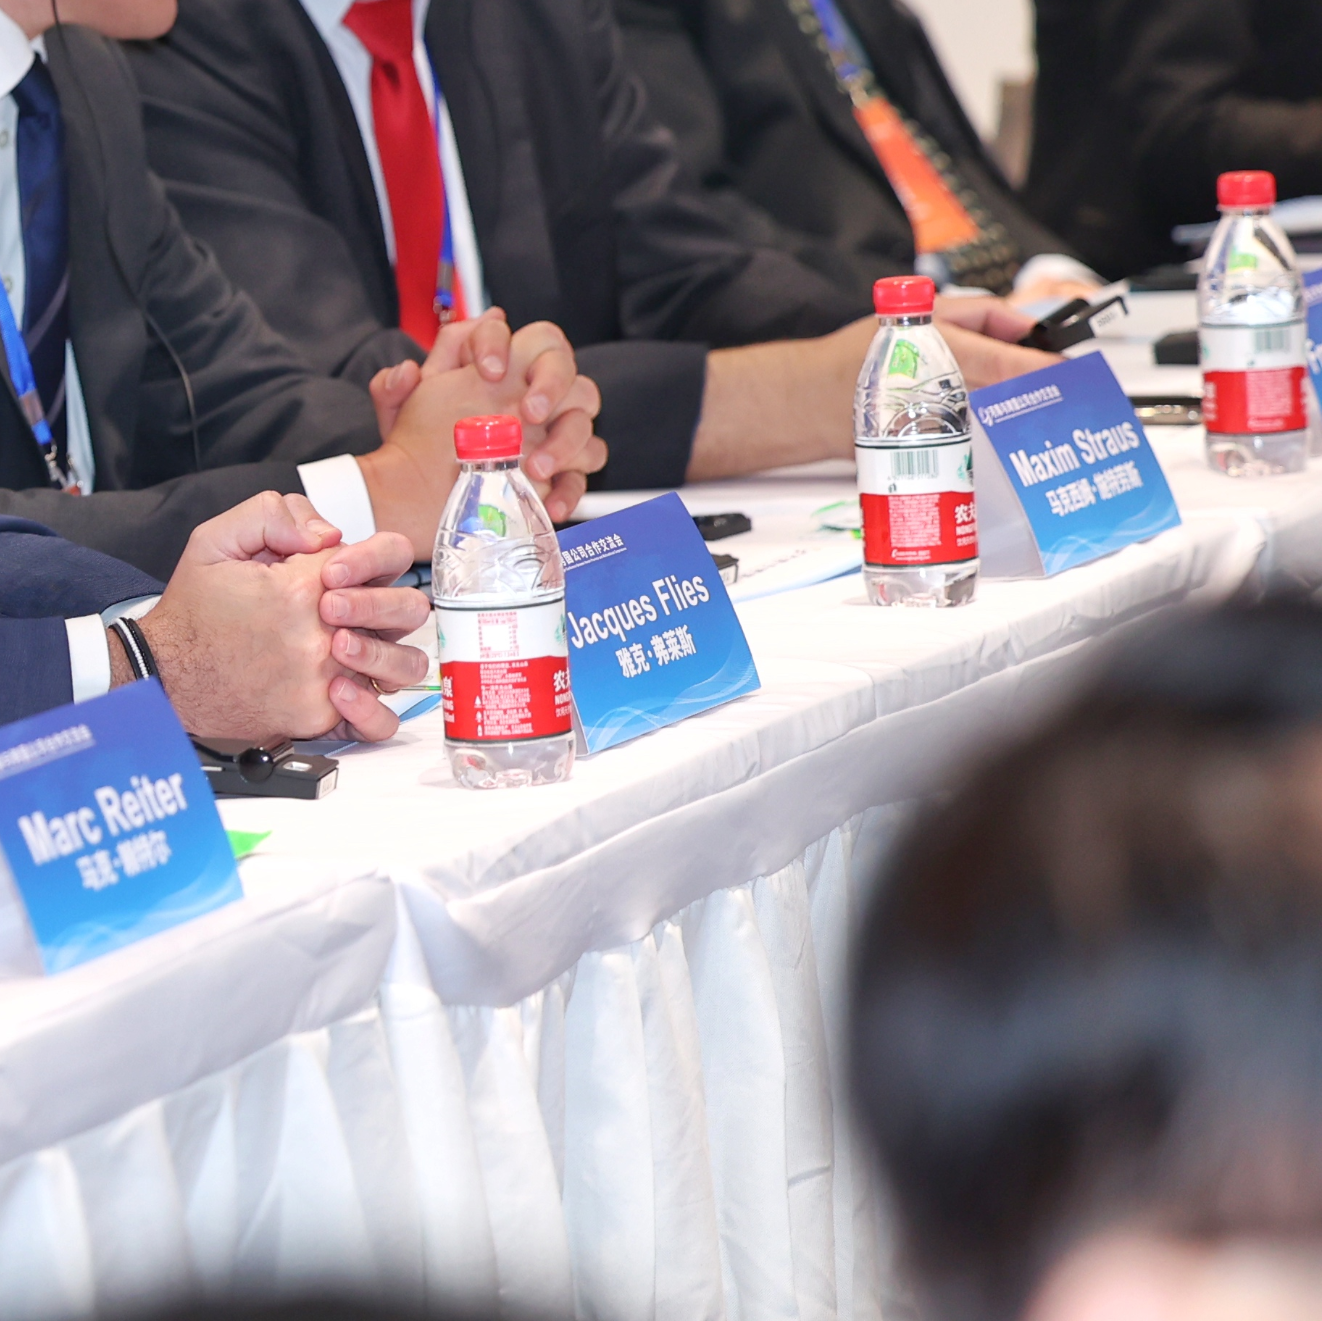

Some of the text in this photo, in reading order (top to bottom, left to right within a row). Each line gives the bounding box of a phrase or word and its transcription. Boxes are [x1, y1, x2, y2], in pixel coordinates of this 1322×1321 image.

[1009, 421, 1140, 487] Maxim Straus
[567, 595, 657, 649] Jacques
[652, 575, 710, 616] Flies
[615, 624, 697, 679] 雅克·弗莱斯
[17, 772, 189, 866] Marc Reiter
